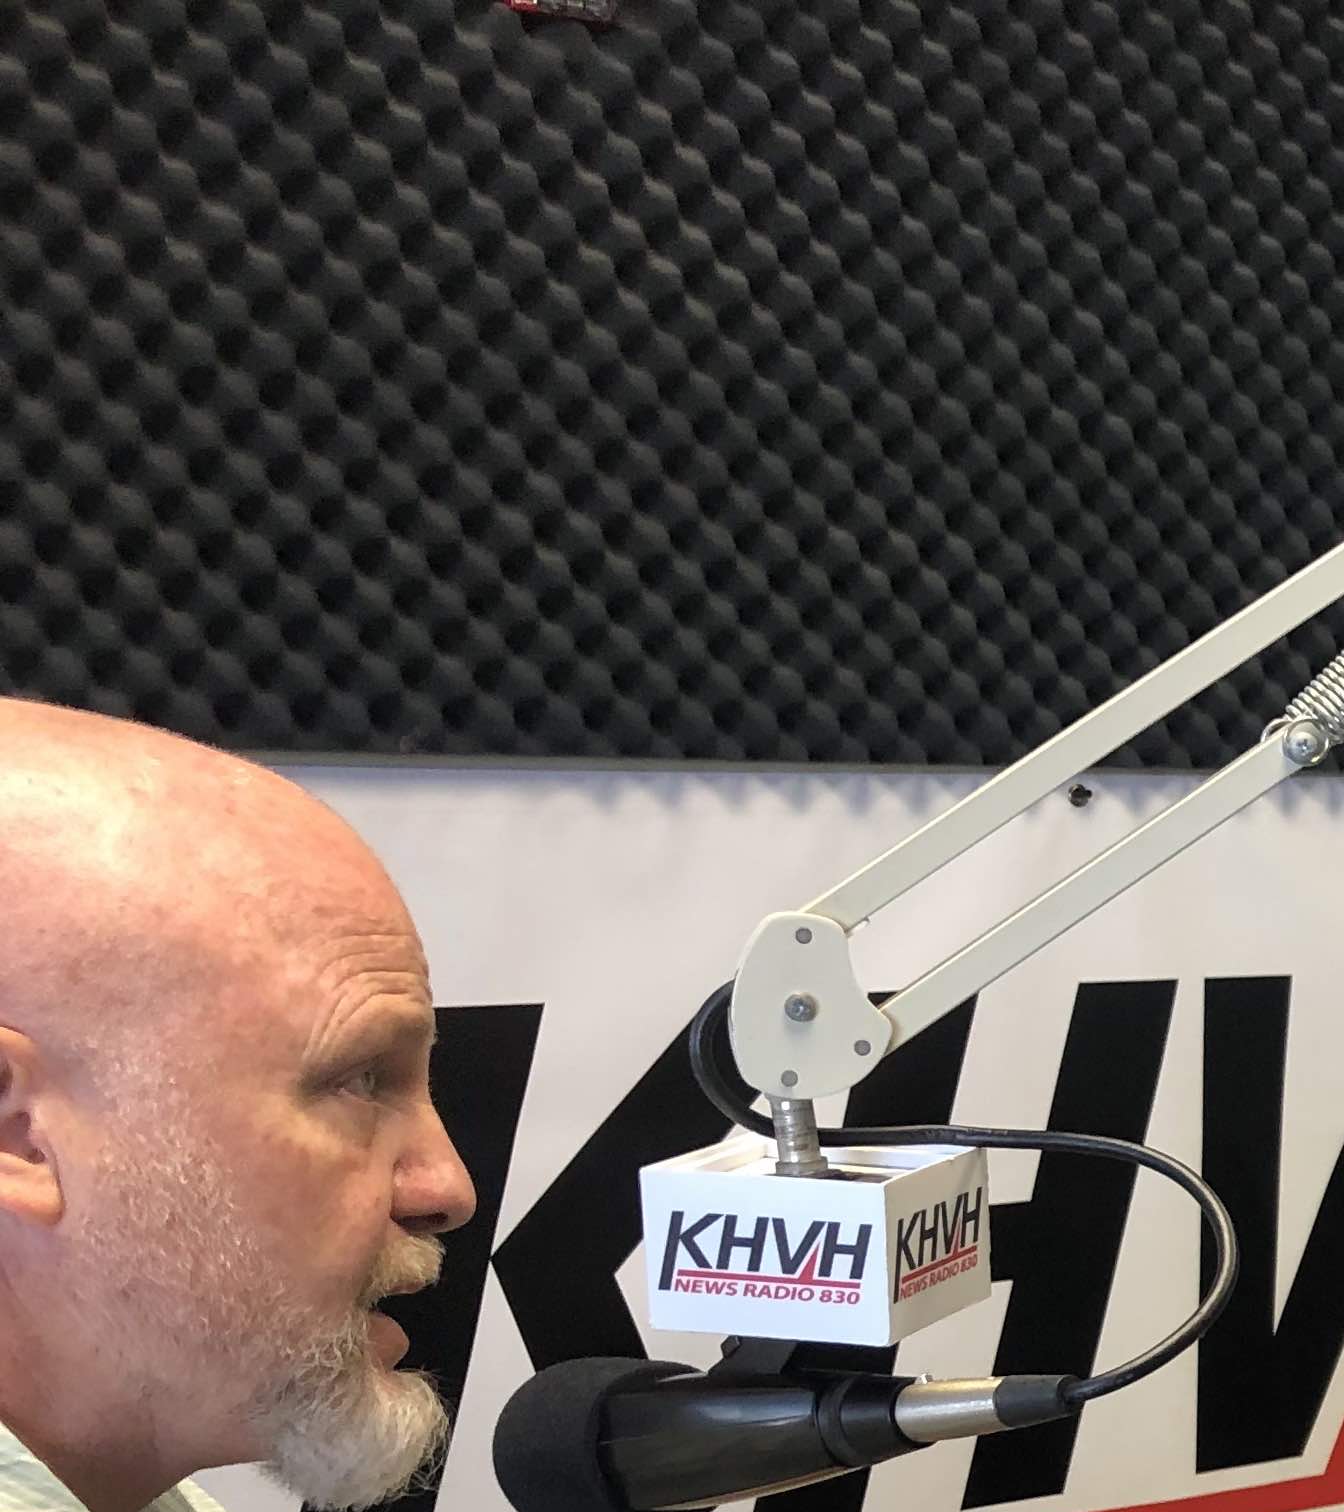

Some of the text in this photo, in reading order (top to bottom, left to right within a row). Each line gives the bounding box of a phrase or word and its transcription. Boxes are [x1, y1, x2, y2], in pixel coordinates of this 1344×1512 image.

[658, 1210, 873, 1291] KHVH
[894, 1186, 983, 1305] KHVH
[900, 1254, 979, 1300] NEWS RADIO 830
[674, 1278, 861, 1305] NEWS RADIO 830
